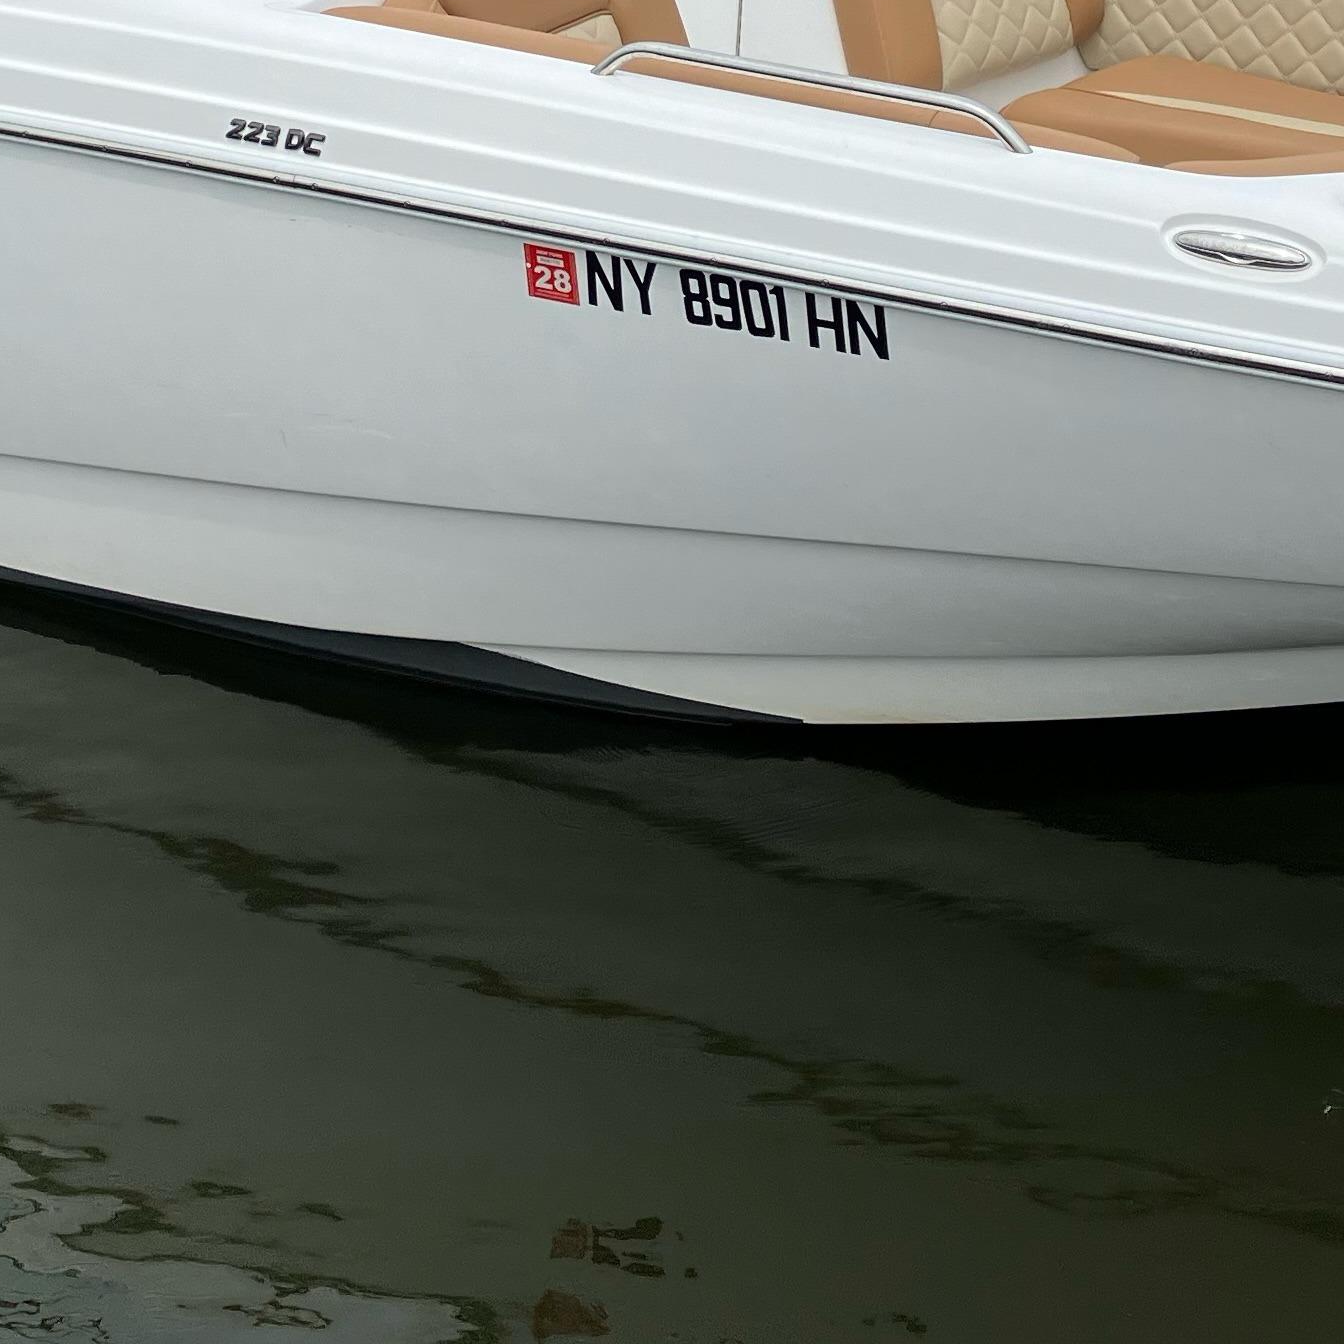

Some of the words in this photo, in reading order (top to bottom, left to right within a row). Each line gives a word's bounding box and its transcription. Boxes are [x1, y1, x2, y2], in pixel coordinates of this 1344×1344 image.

[225, 118, 281, 146] 223
[284, 128, 326, 157] DC
[534, 265, 572, 293] 28
[586, 250, 656, 315] NY
[679, 268, 790, 342] 8901
[805, 291, 890, 361] HN
